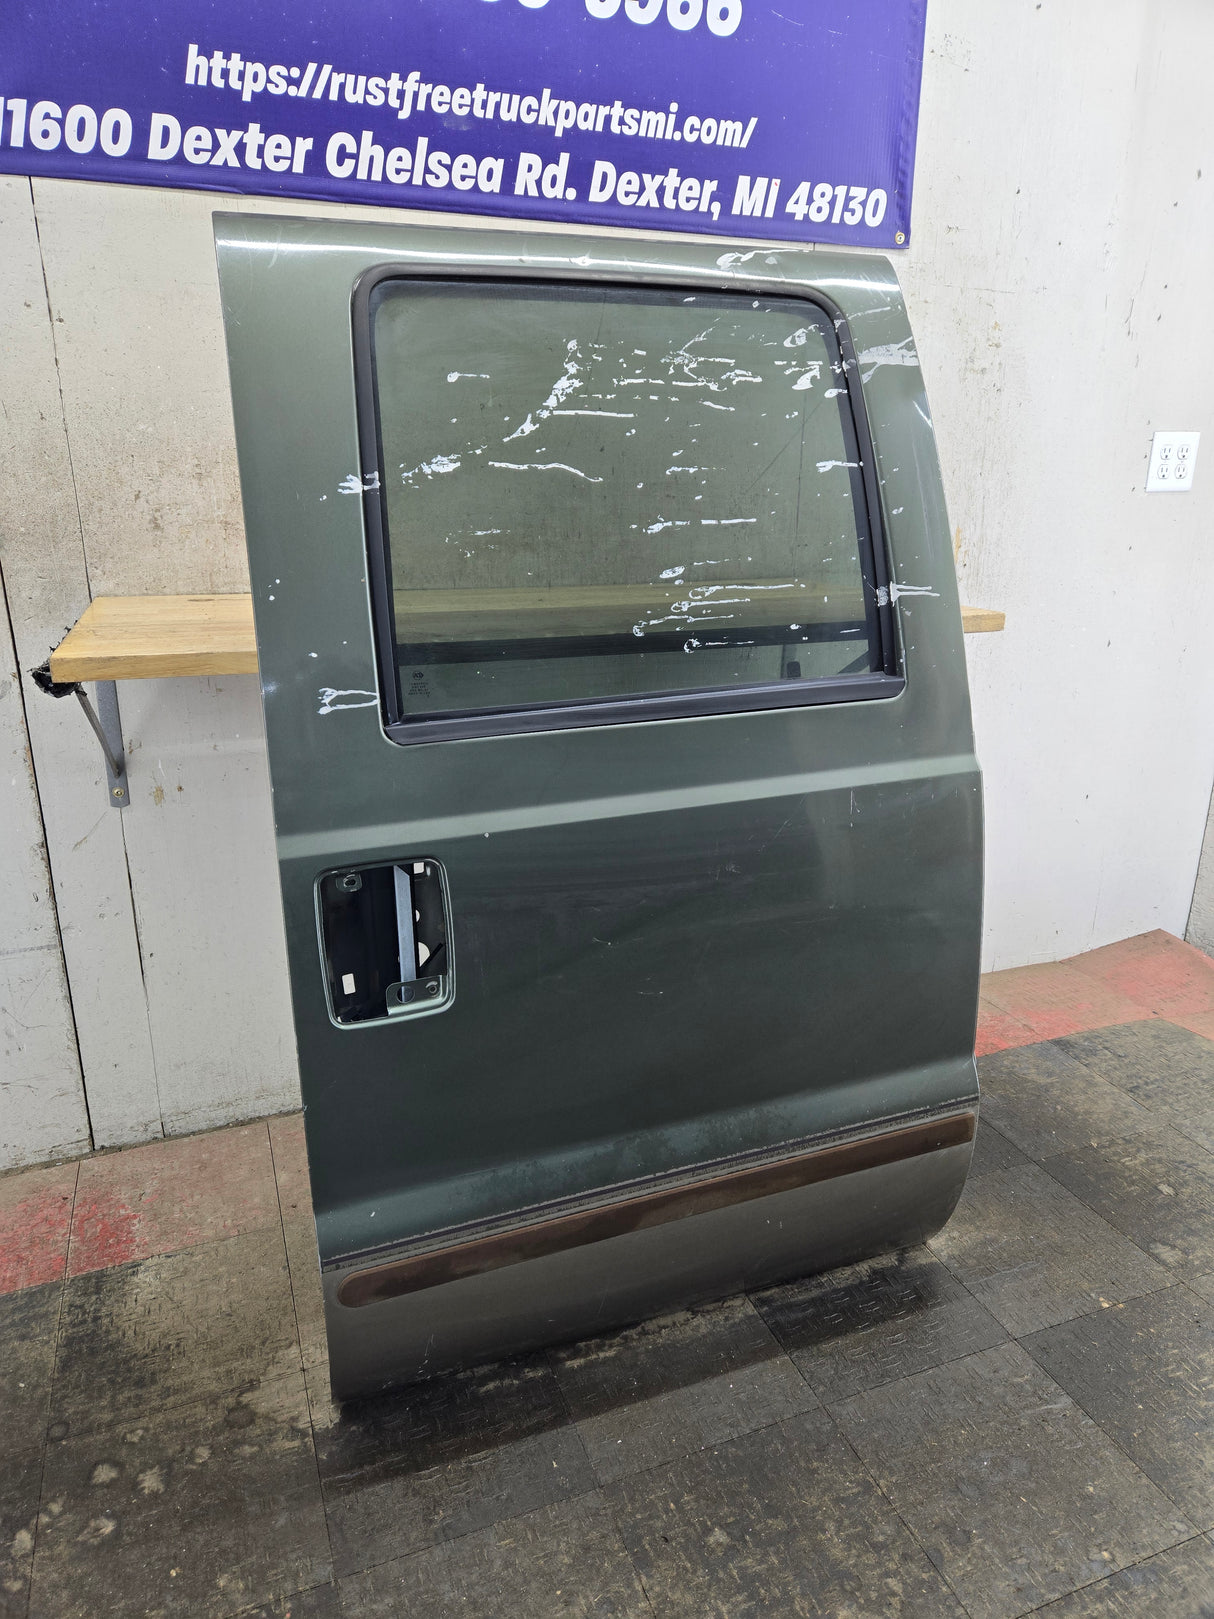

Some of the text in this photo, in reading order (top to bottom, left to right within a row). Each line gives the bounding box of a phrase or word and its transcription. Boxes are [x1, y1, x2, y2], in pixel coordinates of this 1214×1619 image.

[185, 43, 758, 149] https://rustfreetruckpartsmi.com/
[0, 96, 888, 228] 1600 Dexter Chelsea Rd. Dexter, MI 48130
